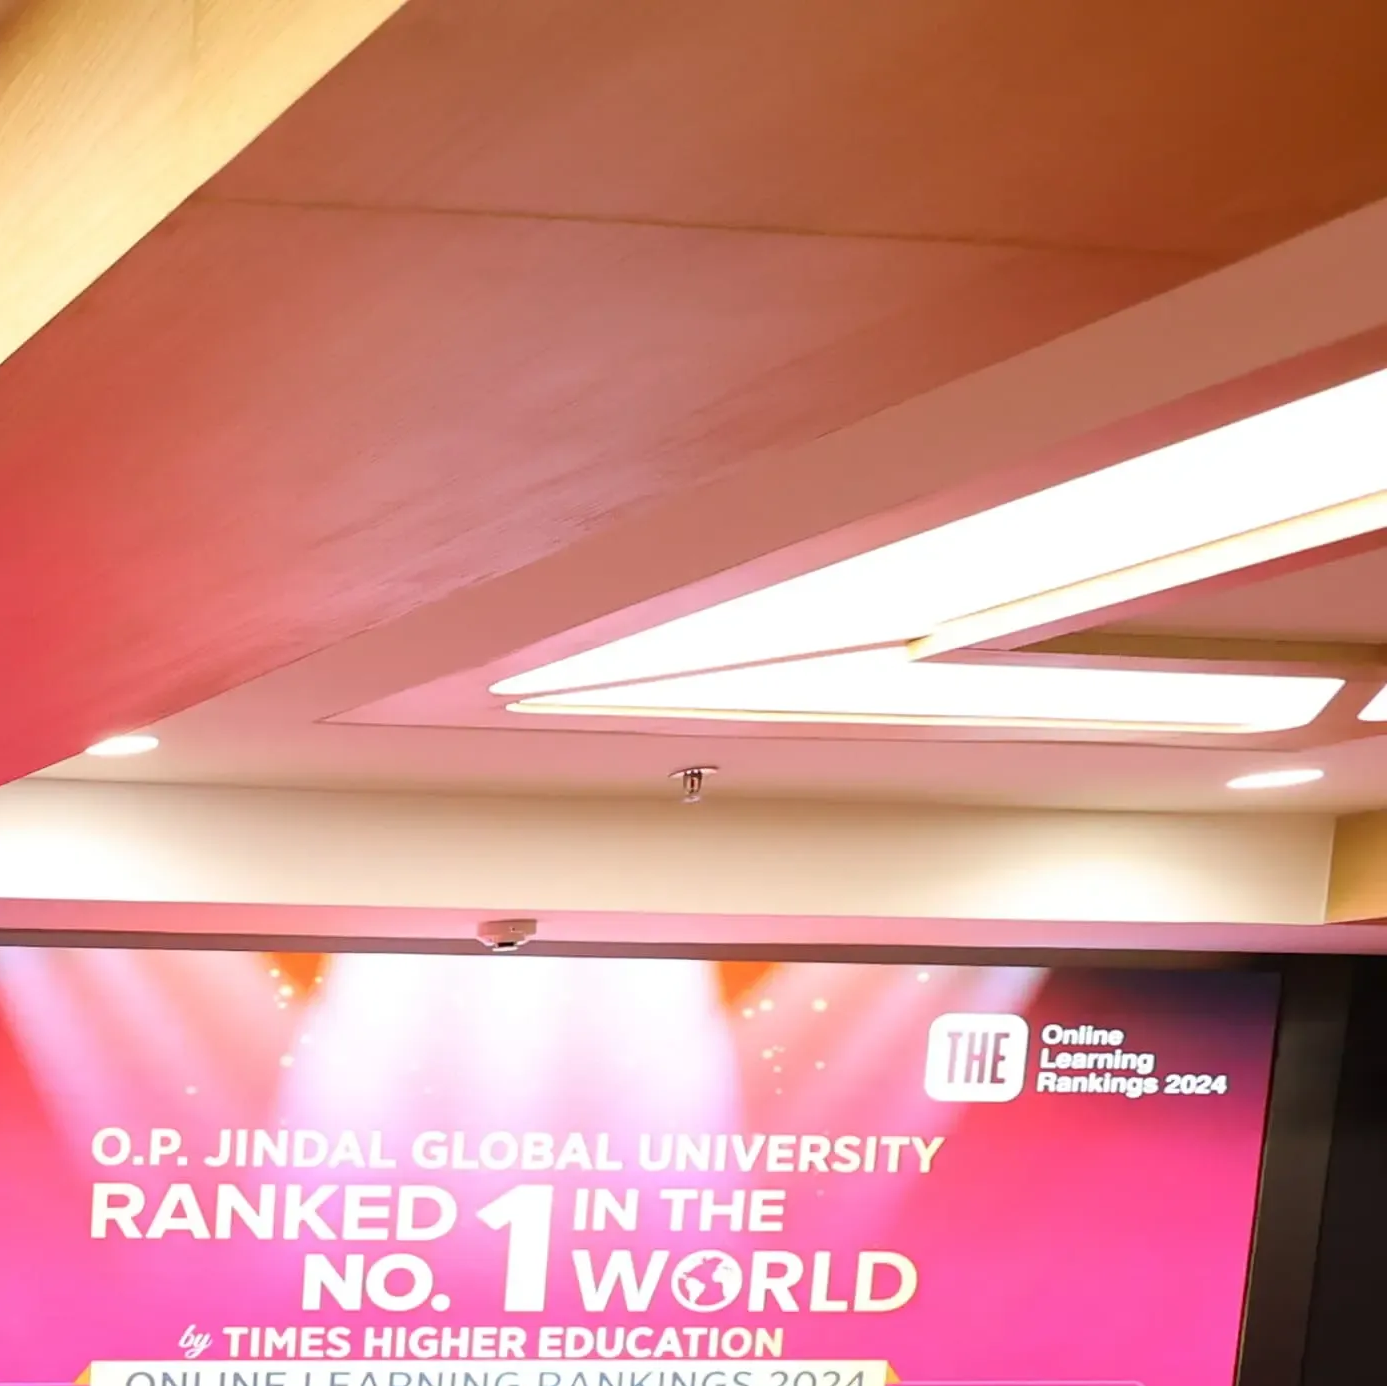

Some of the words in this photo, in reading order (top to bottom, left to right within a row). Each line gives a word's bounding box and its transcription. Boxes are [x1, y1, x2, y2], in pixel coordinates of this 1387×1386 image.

[1042, 1025, 1124, 1045] Online
[948, 1033, 1010, 1084] THE
[1039, 1048, 1154, 1075] Learning
[1037, 1071, 1158, 1098] Rankings
[1164, 1074, 1227, 1094] 2024
[91, 1128, 188, 1167] O.P.
[204, 1129, 395, 1169] JINDAL
[412, 1131, 621, 1172] GLOBAL
[638, 1135, 945, 1174] UNIVERSITY
[91, 1183, 456, 1240] RANKED
[478, 1186, 552, 1312] 1
[574, 1189, 638, 1230] IN
[661, 1190, 786, 1231] THE
[302, 1254, 450, 1311] NO.
[178, 1324, 213, 1361] by
[223, 1327, 350, 1357] TIMES
[364, 1327, 526, 1358] HIGHER
[539, 1327, 783, 1358] EDUCATION
